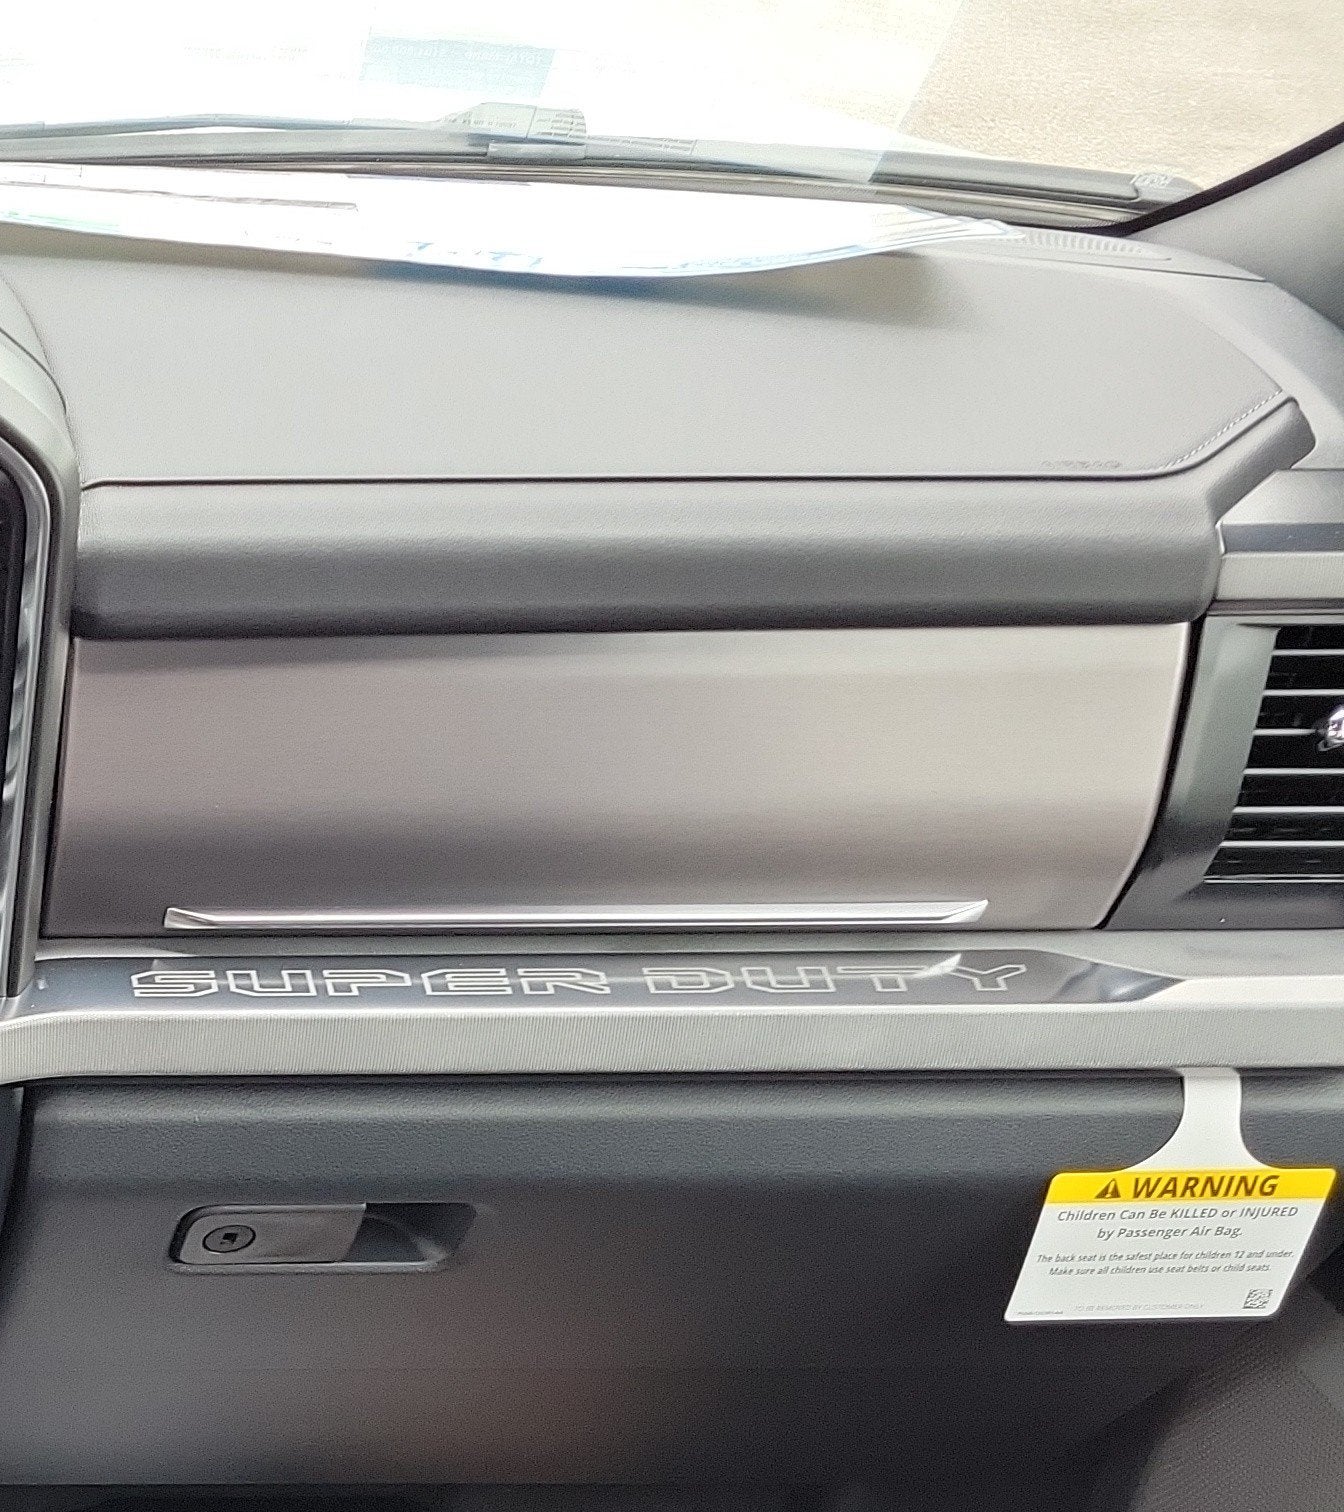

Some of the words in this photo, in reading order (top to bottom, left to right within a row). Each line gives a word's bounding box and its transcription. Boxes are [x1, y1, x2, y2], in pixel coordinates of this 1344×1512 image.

[130, 968, 609, 997] SUPER
[642, 964, 1026, 994] DUTY
[1132, 1175, 1280, 1199] WARNING
[1058, 1210, 1116, 1221] Children
[1120, 1209, 1145, 1220] Can
[1149, 1209, 1167, 1219] Be
[1170, 1208, 1218, 1218] KILLED
[1221, 1209, 1237, 1218] or
[1239, 1206, 1298, 1219] INJURED
[1097, 1228, 1115, 1241] by
[1117, 1227, 1188, 1239] Passenger
[1189, 1226, 1212, 1236] Air
[1214, 1226, 1243, 1238] Bag.
[1037, 1254, 1053, 1262] The
[1078, 1254, 1097, 1262] seat
[1126, 1252, 1152, 1261] safest
[1154, 1252, 1177, 1262] place
[1180, 1251, 1193, 1260] for
[1195, 1251, 1231, 1260] children
[1246, 1250, 1265, 1258] and
[1111, 1266, 1147, 1274] children
[1165, 1265, 1185, 1273] seat
